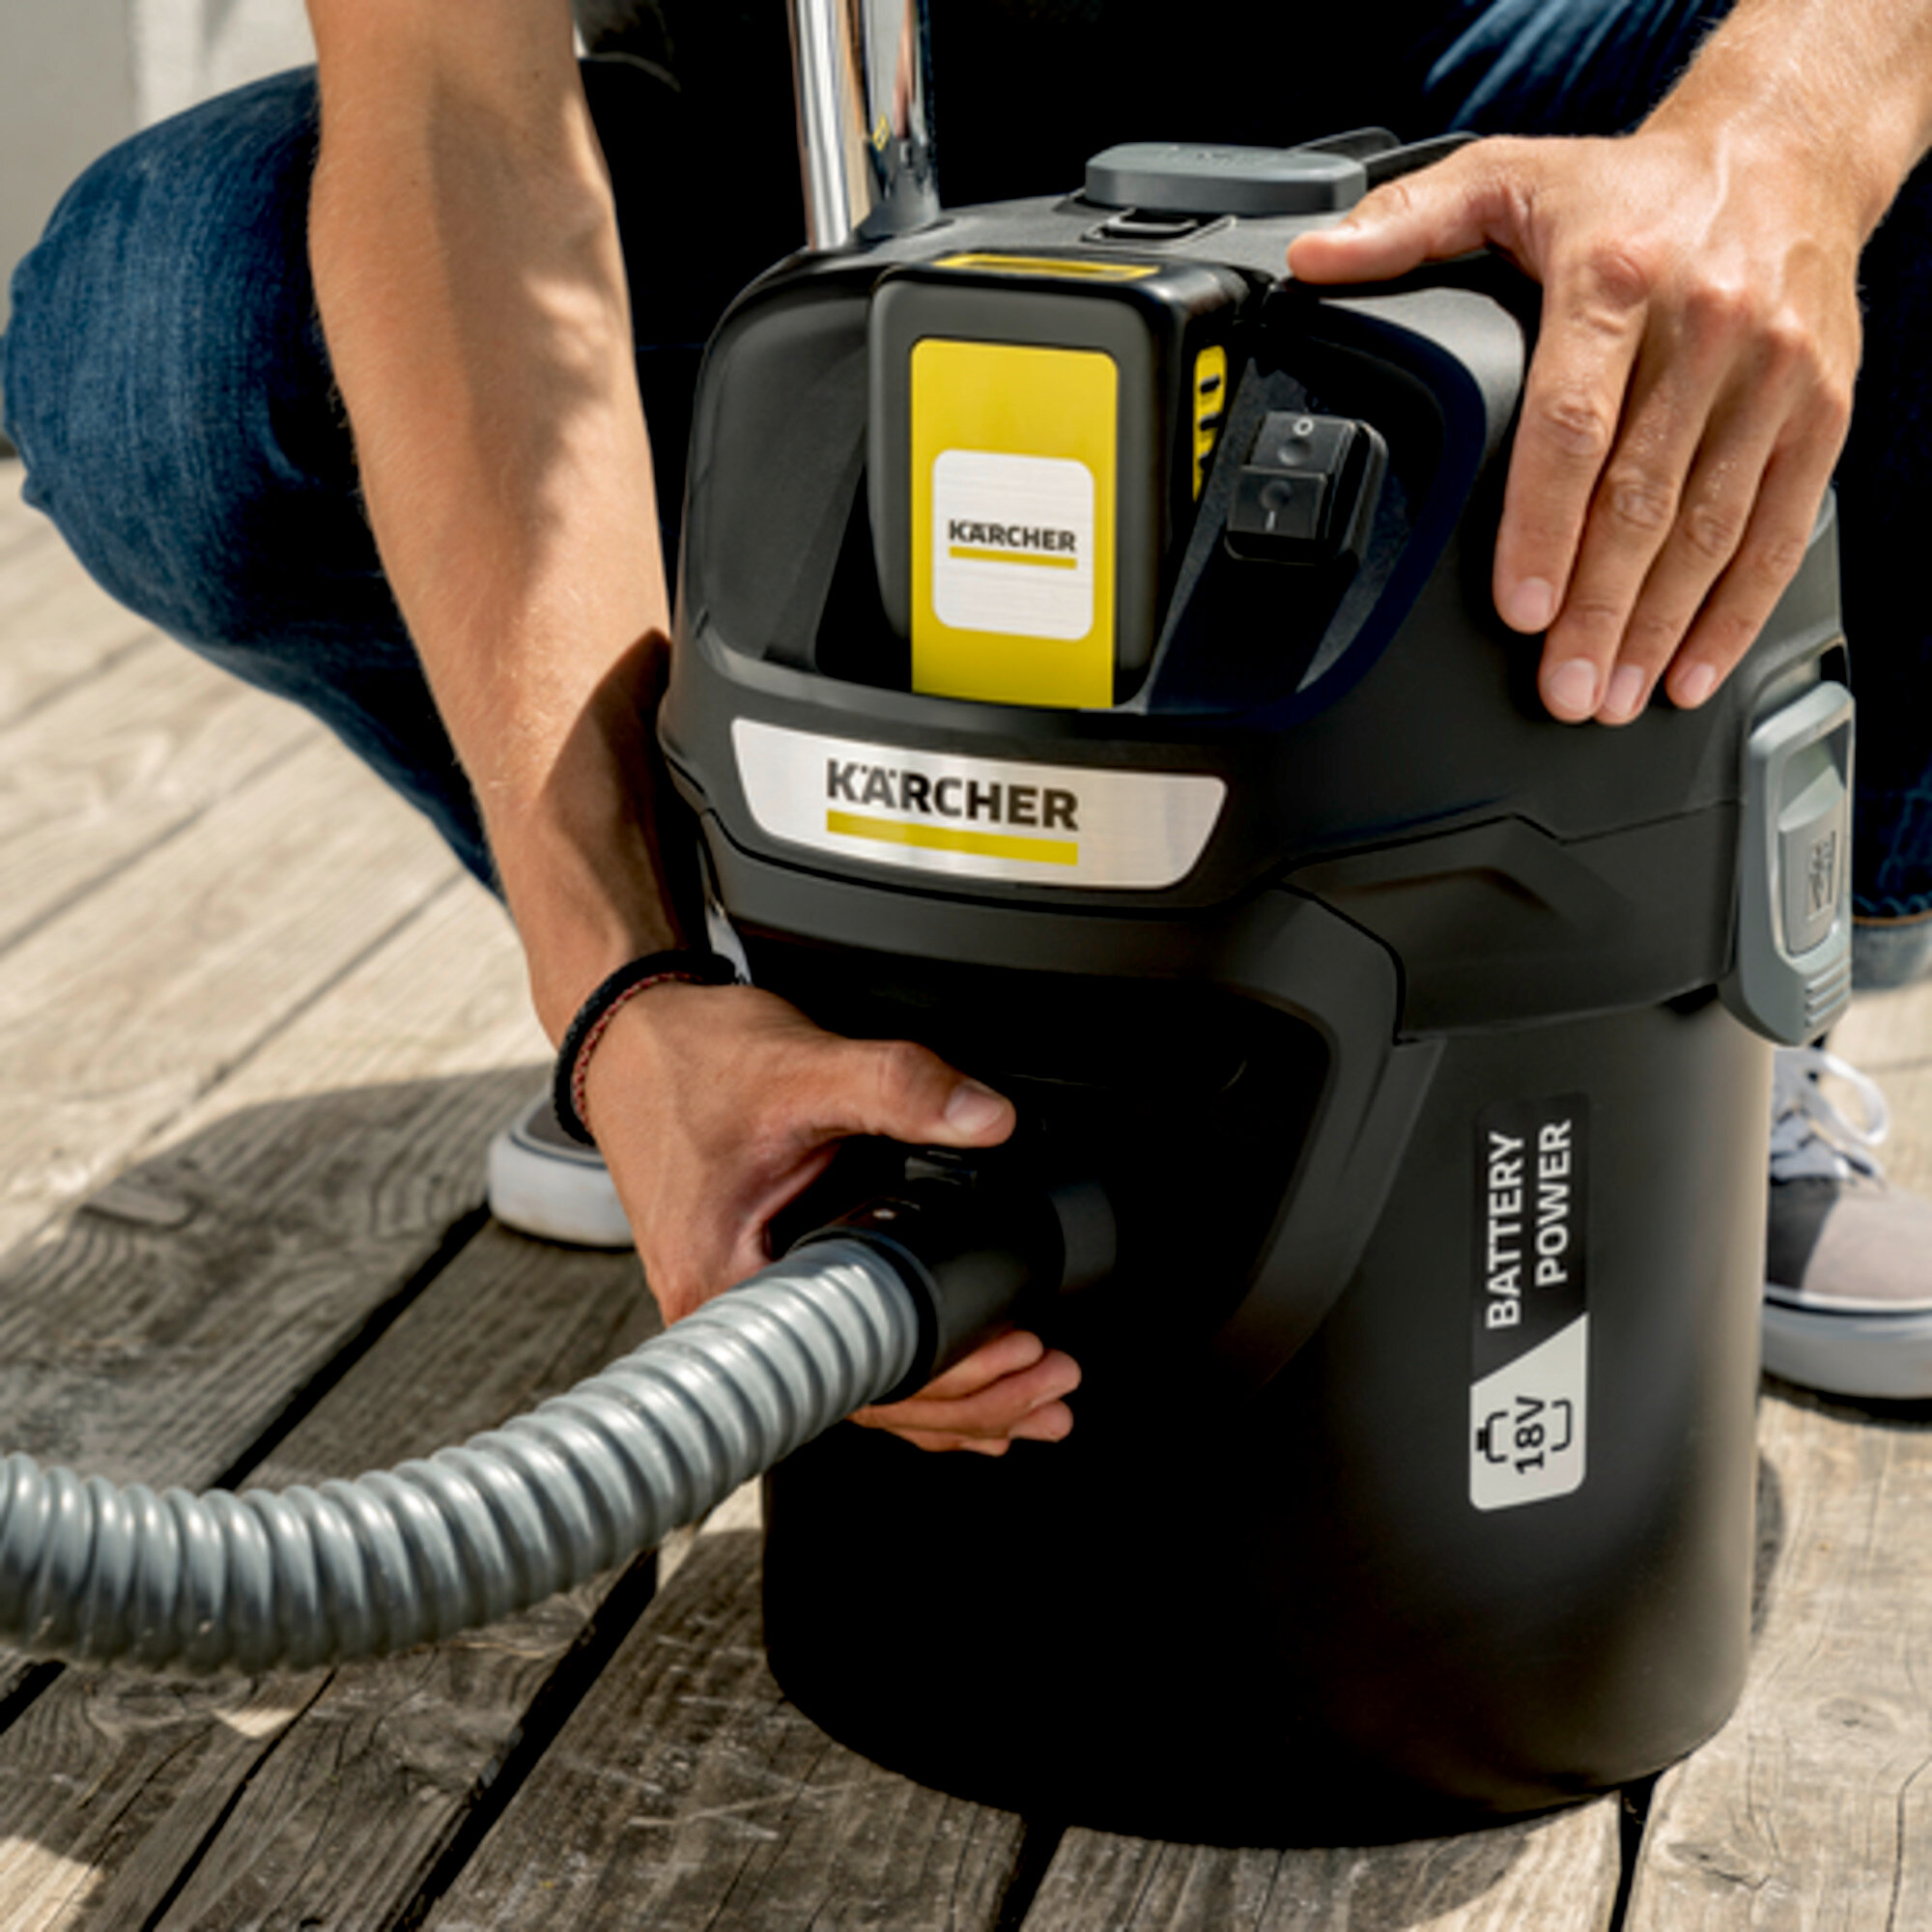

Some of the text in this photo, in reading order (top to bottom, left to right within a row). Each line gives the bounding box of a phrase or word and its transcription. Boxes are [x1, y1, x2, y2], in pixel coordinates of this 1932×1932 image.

[949, 519, 1076, 552] KÄRCHER
[826, 758, 1079, 831] KÄRCHER
[1486, 1132, 1525, 1329] BATTERY
[1536, 1119, 1573, 1287] POWER
[1515, 1396, 1546, 1474] 18V
